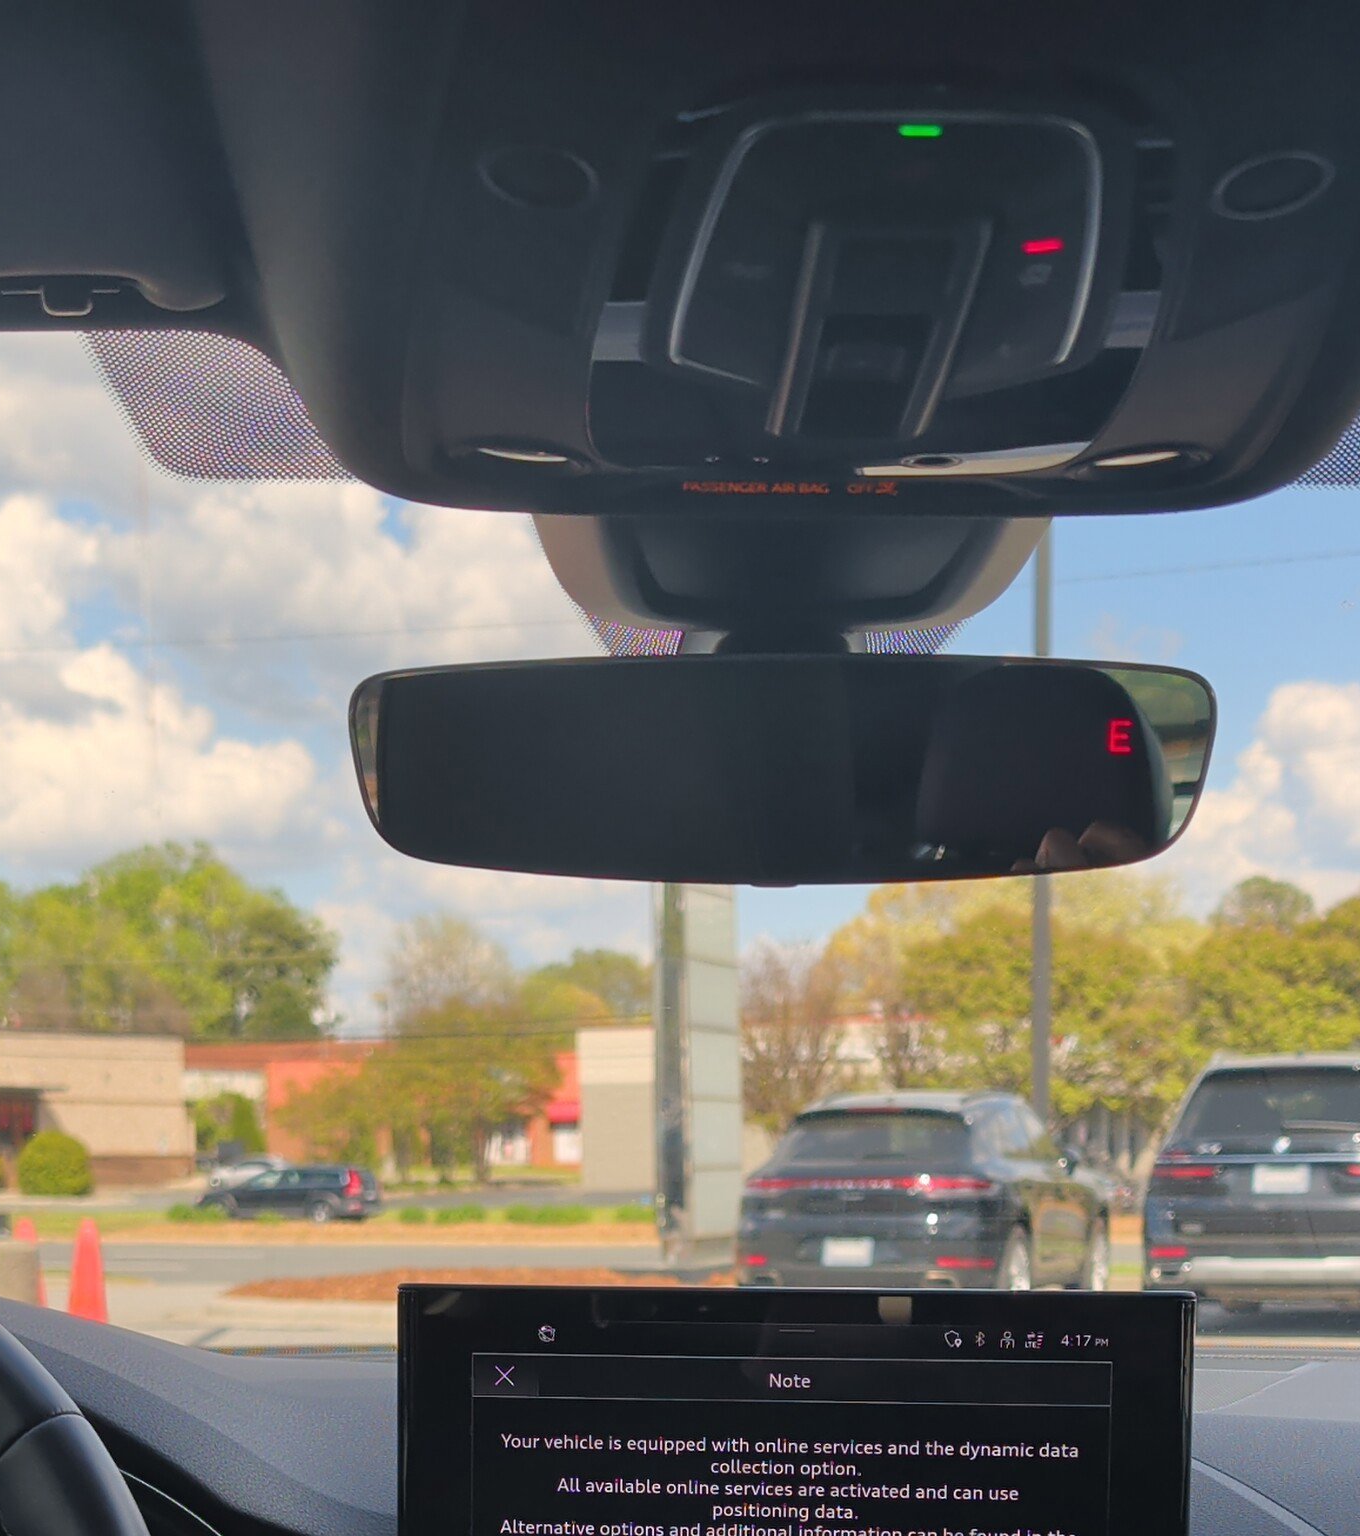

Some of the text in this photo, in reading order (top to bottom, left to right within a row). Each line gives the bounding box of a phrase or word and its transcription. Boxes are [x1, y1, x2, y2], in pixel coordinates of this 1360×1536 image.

[683, 480, 767, 494] PASSENGER
[772, 482, 795, 494] AIR
[798, 482, 830, 494] BAG
[1107, 718, 1134, 755] E
[1061, 1334, 1092, 1348] 4:17
[1095, 1338, 1109, 1347] PM
[769, 1373, 811, 1389] Note
[501, 1434, 1079, 1460] Your vehicle is equipped with online services and the dynamic data
[710, 1459, 862, 1479] collection option.
[557, 1478, 1019, 1502] All available online services are activated and can use
[712, 1502, 859, 1523] positioning data.
[500, 1519, 595, 1536] Alternative
